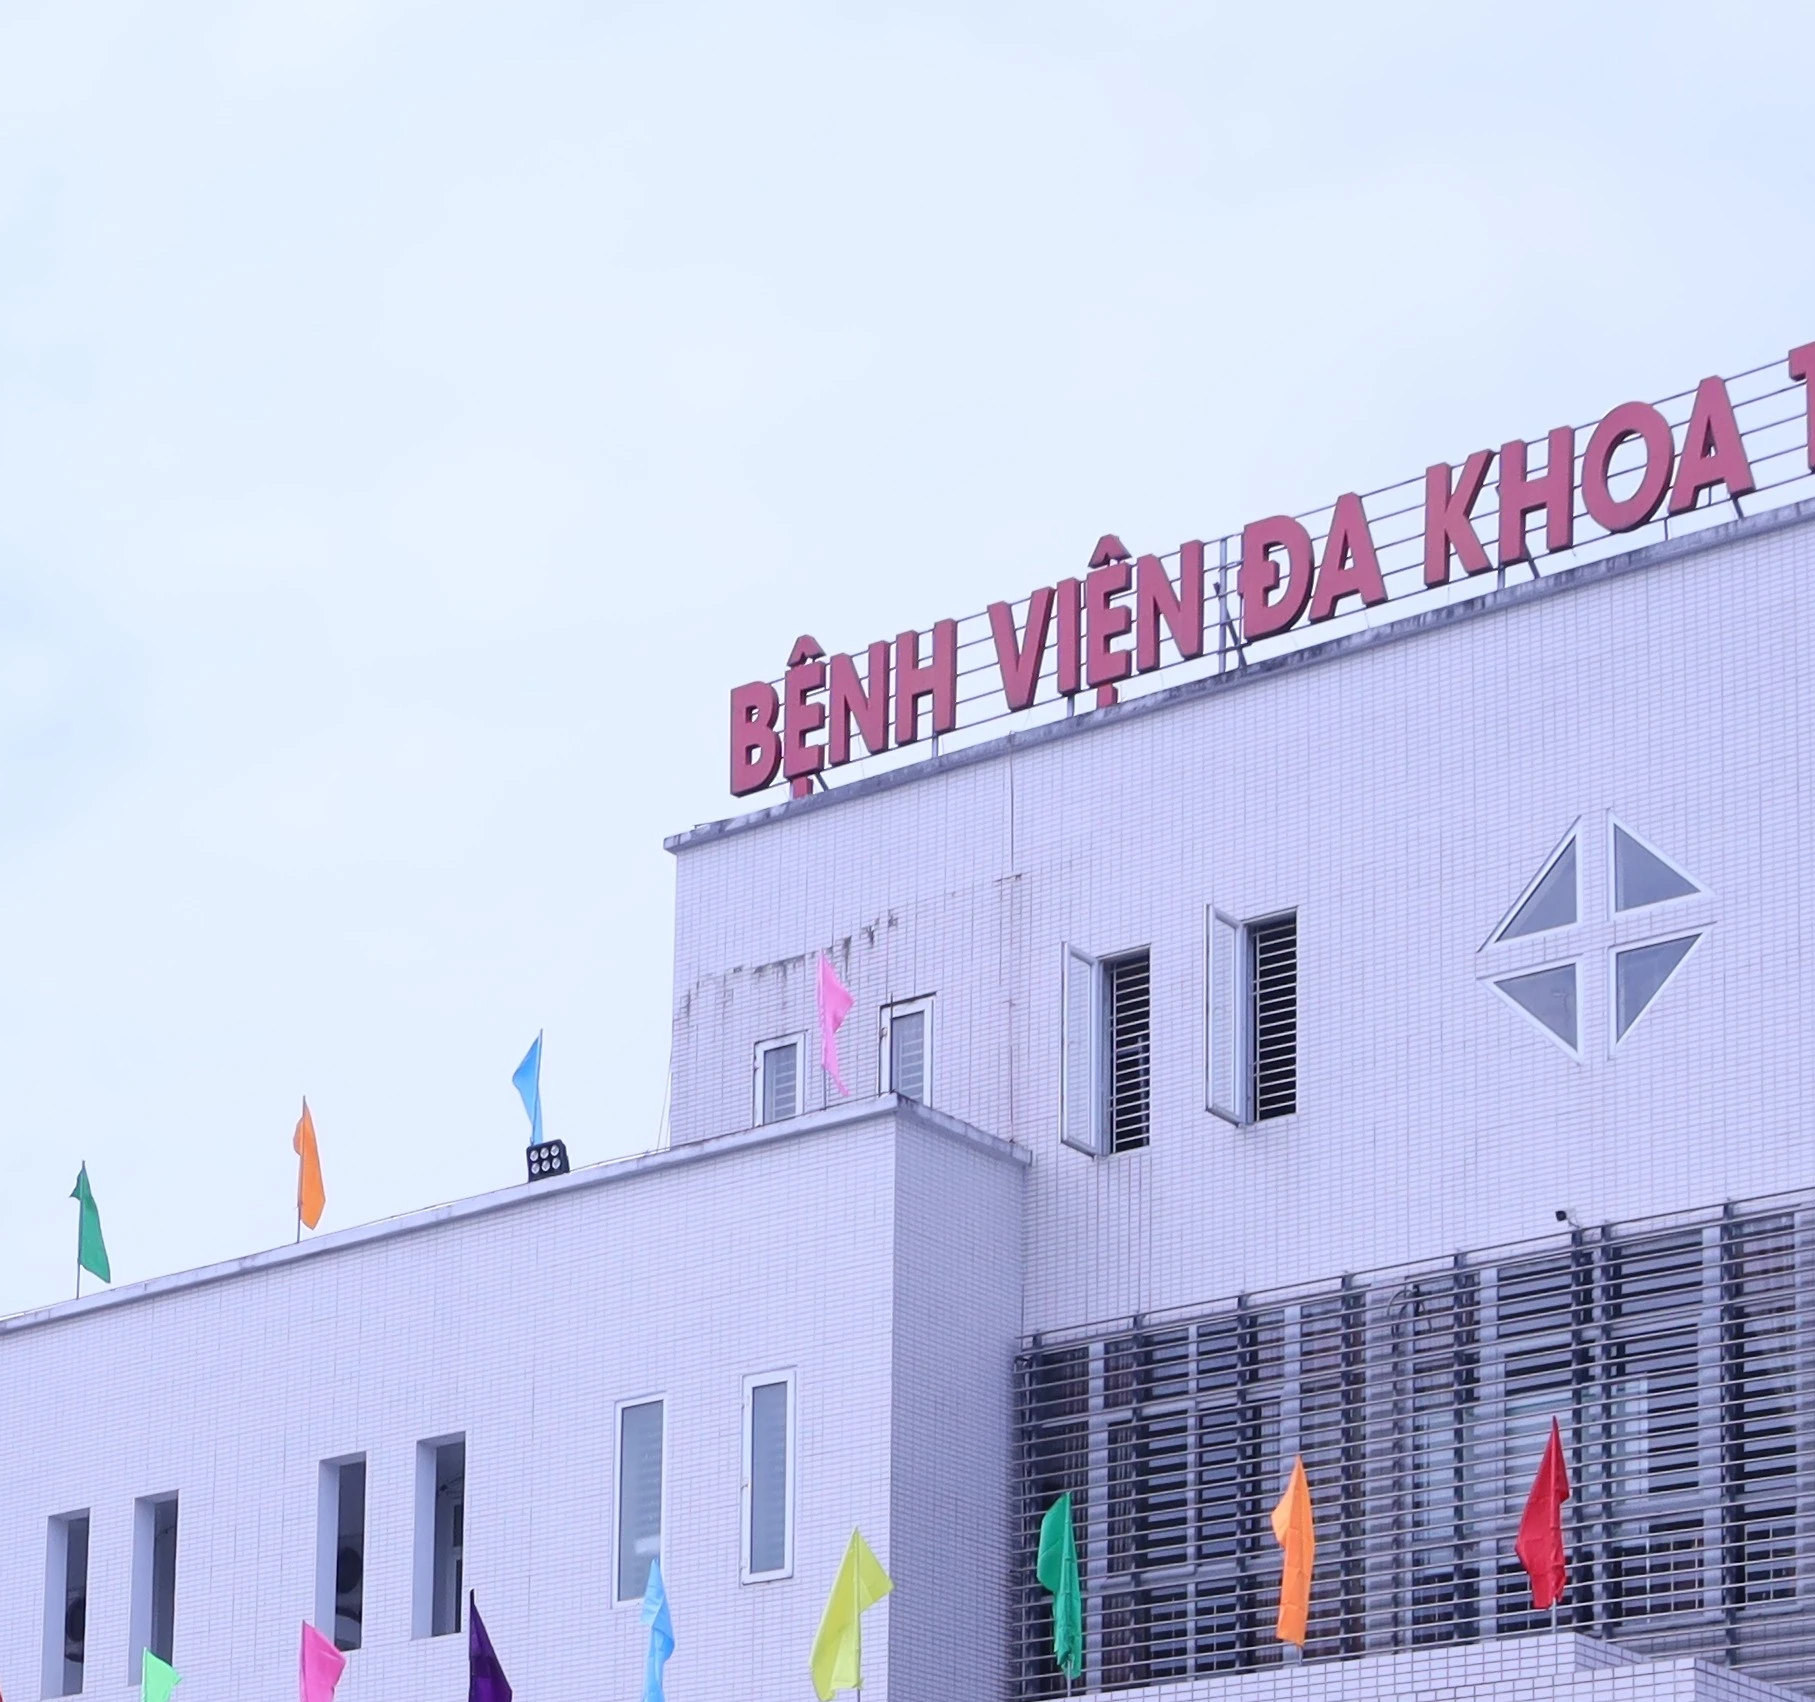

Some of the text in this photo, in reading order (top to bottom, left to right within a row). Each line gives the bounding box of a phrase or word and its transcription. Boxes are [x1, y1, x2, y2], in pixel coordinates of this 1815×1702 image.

[730, 634, 958, 800] BỆNH
[987, 534, 1204, 708] VIỆN
[1241, 491, 1387, 640] ĐA
[1423, 376, 1756, 587] KHOA
